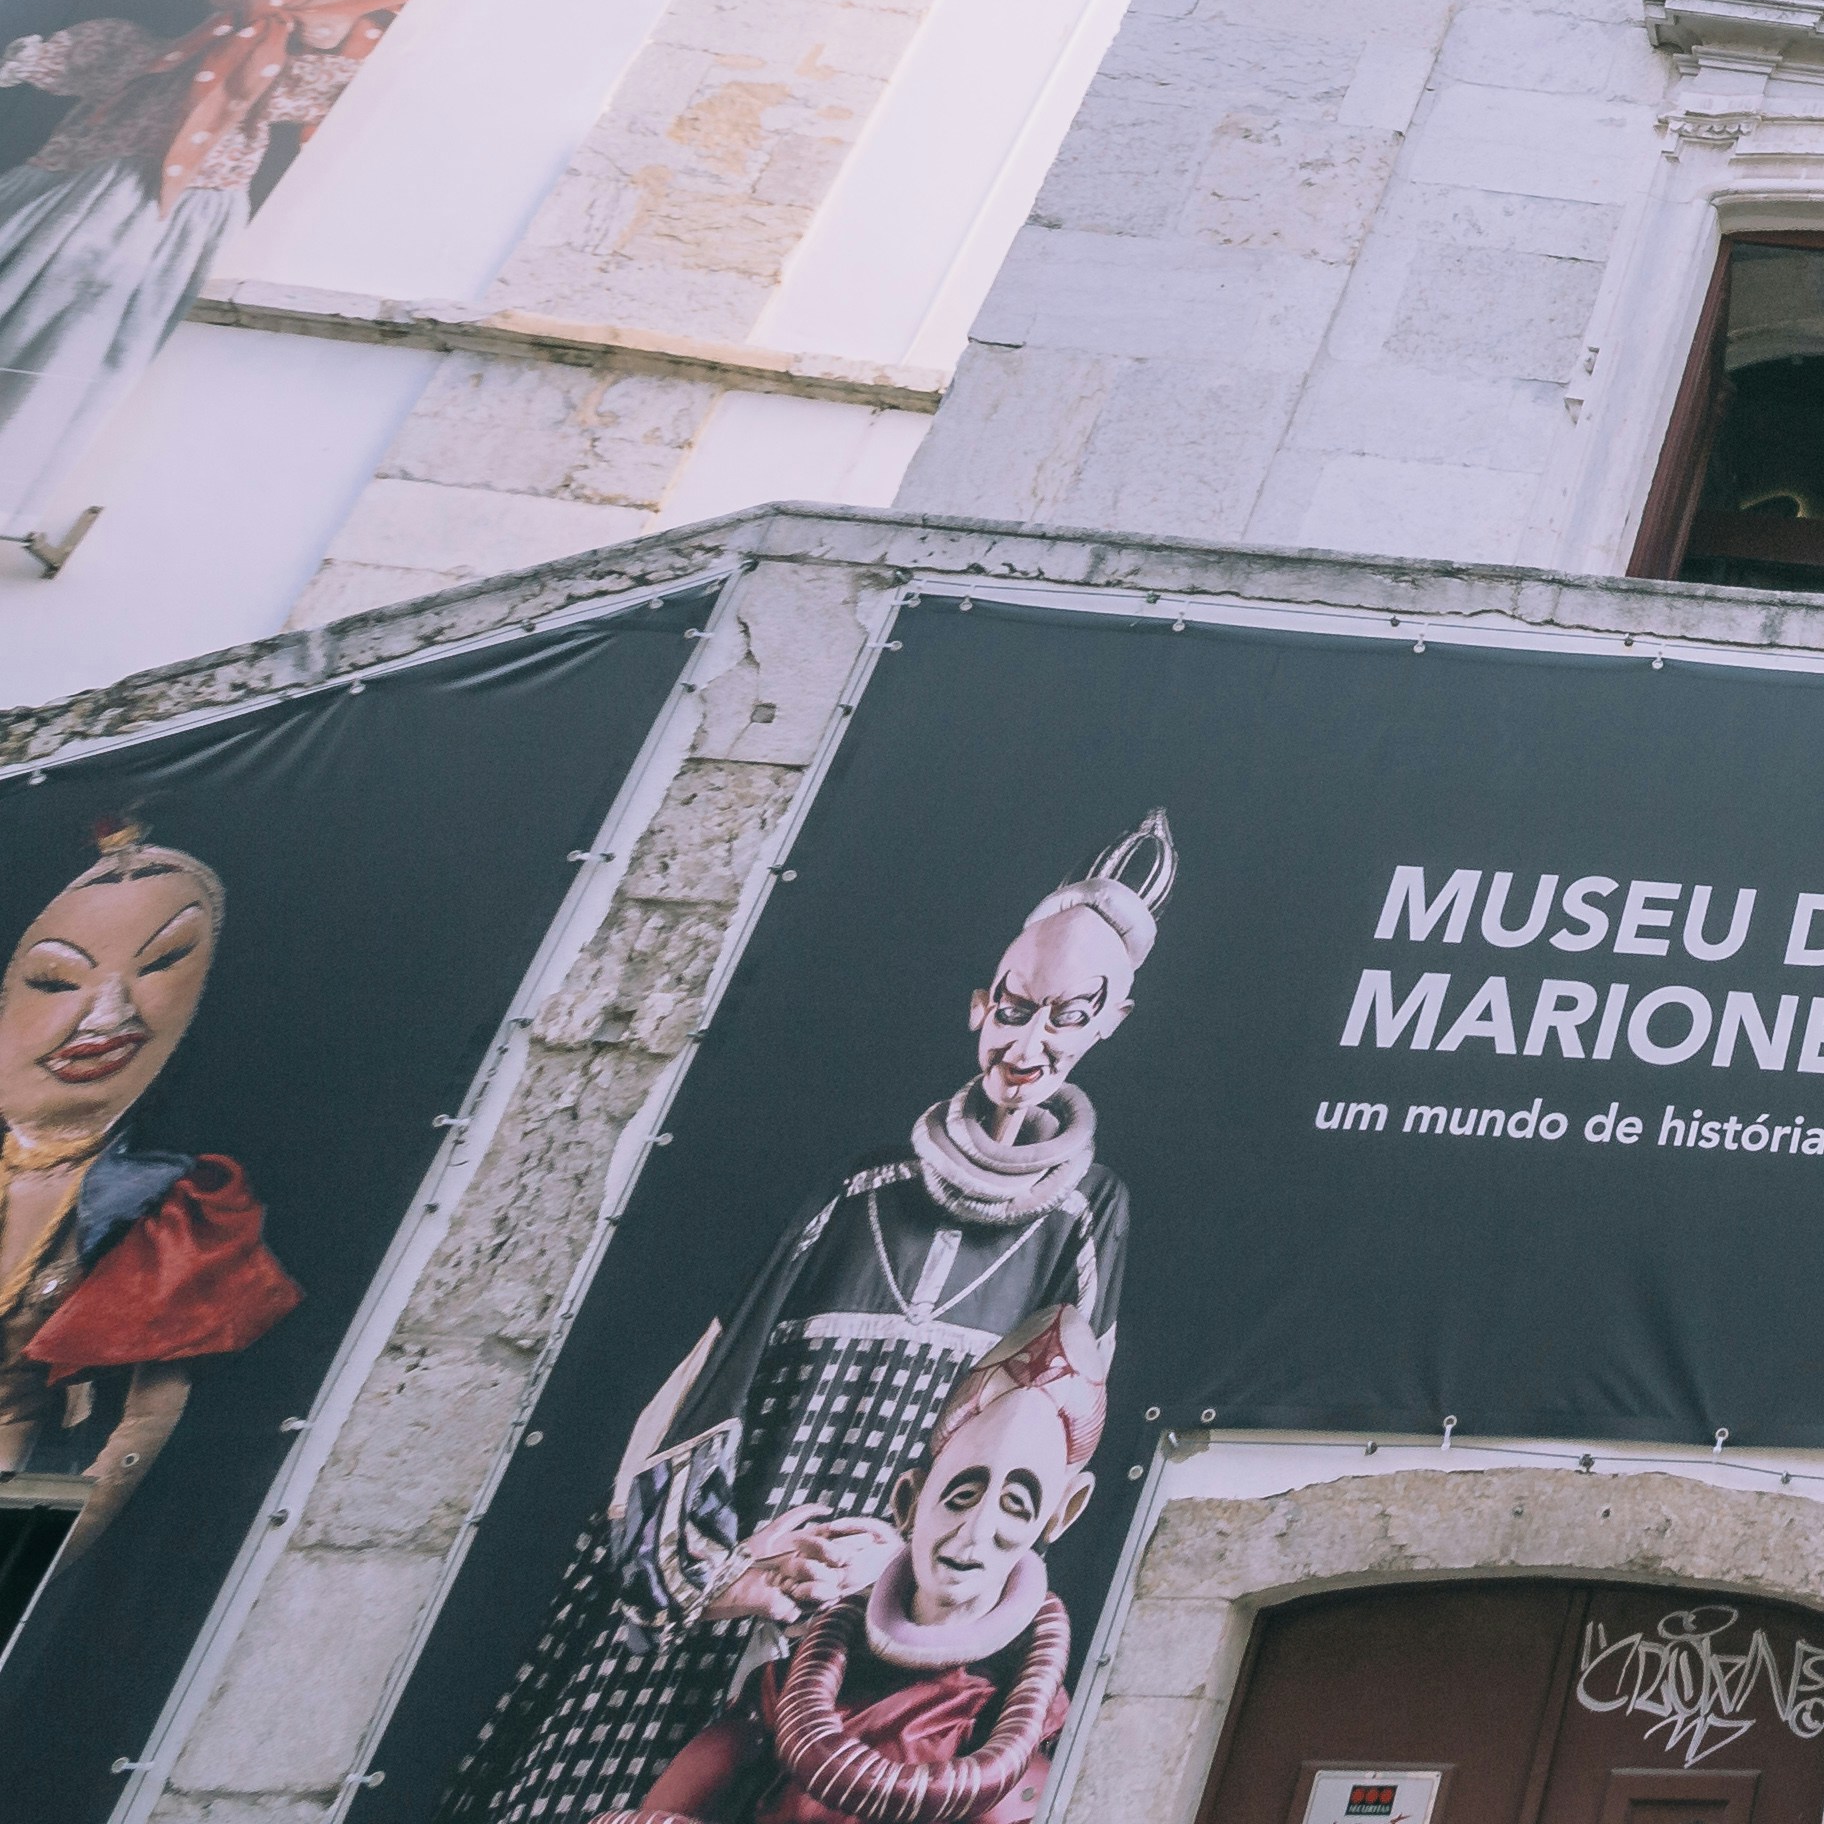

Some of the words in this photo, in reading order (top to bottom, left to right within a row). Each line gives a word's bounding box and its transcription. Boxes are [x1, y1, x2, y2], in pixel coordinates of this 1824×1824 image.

[1374, 866, 1757, 961] MUSEU
[1316, 1102, 1388, 1131] um
[1403, 1098, 1568, 1139] mundo
[1584, 1102, 1642, 1144] de
